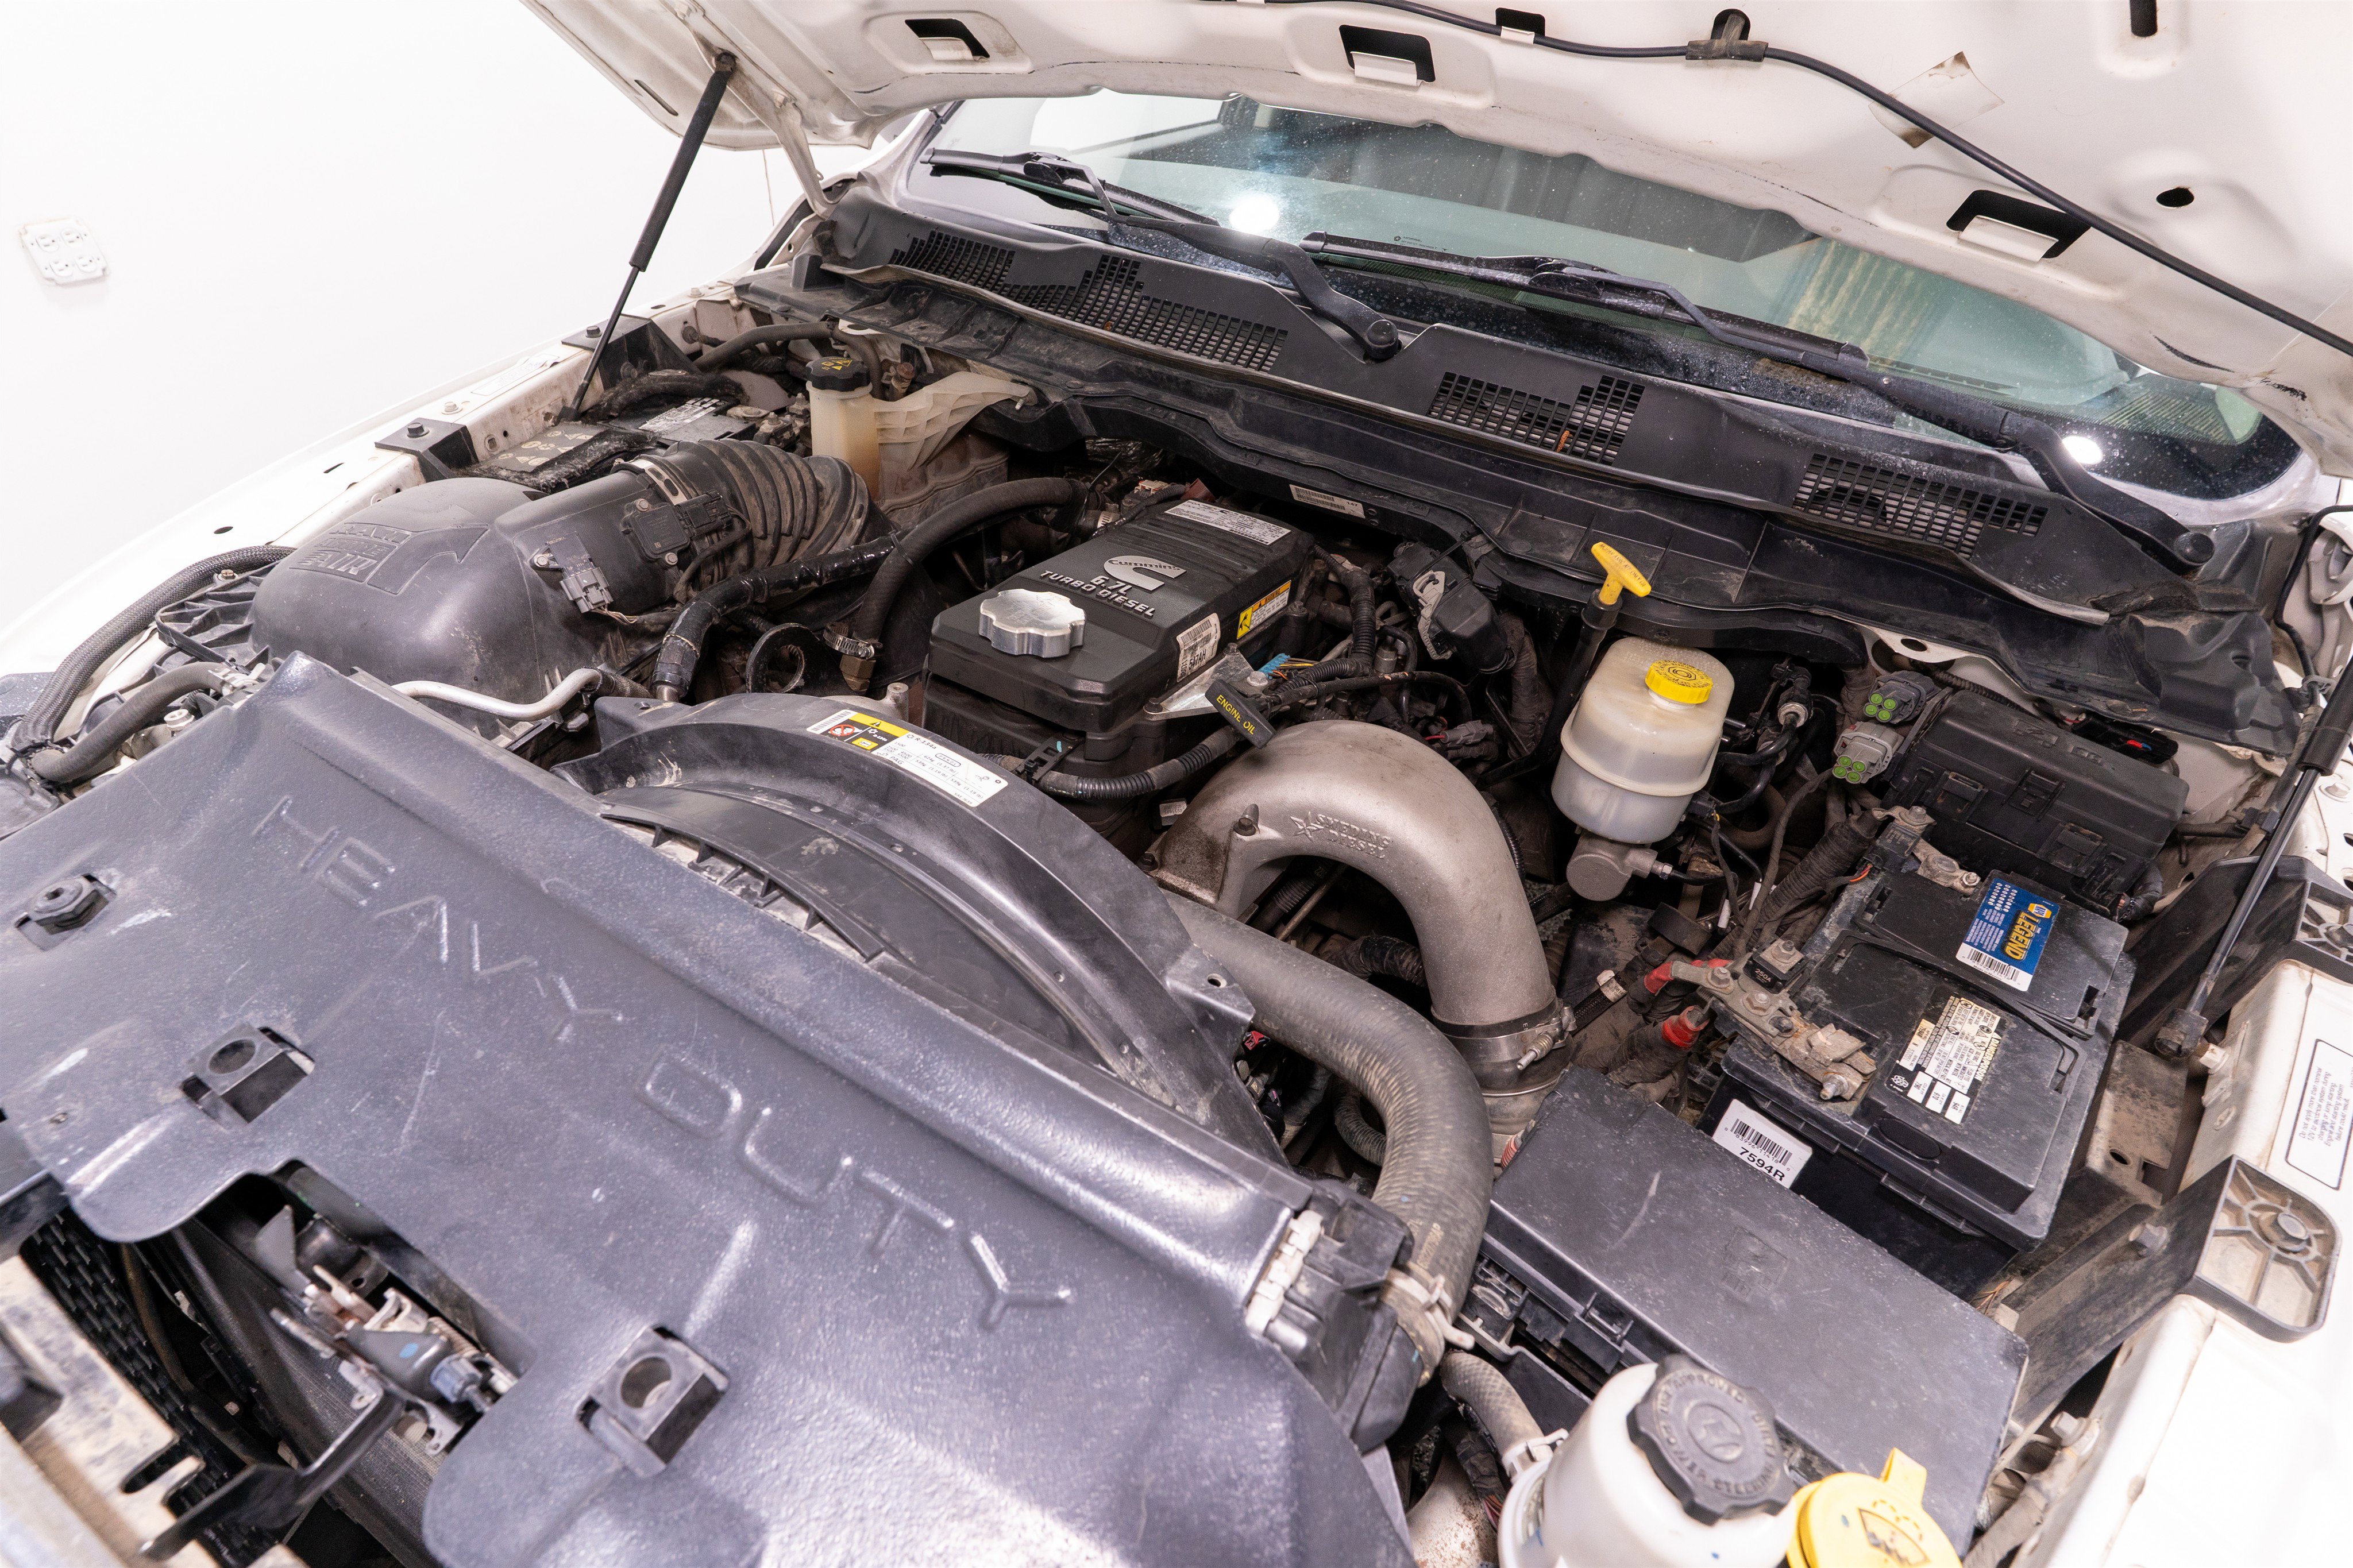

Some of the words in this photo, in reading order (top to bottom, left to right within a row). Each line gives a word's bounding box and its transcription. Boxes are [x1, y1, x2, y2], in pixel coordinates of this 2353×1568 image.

[1108, 560, 1180, 570] Cummins
[1039, 569, 1096, 593] TURBO
[1096, 588, 1155, 618] DIESEL
[1090, 573, 1132, 596] 6.7L
[1216, 694, 1240, 722] ENGINE
[1243, 720, 1255, 735] OIL
[889, 755, 903, 765] PAG
[1326, 829, 1384, 859] DIESEL
[250, 794, 626, 1045] HEAVY
[2003, 910, 2039, 961] LEGEND
[1974, 1037, 1999, 1081] DANGER/POISON
[1931, 1091, 1941, 1100] 970
[1734, 1133, 1756, 1149] 83996
[1758, 1148, 1779, 1164] 11418
[1738, 1146, 1786, 1181] 7594R
[632, 1042, 1076, 1331] DUTY
